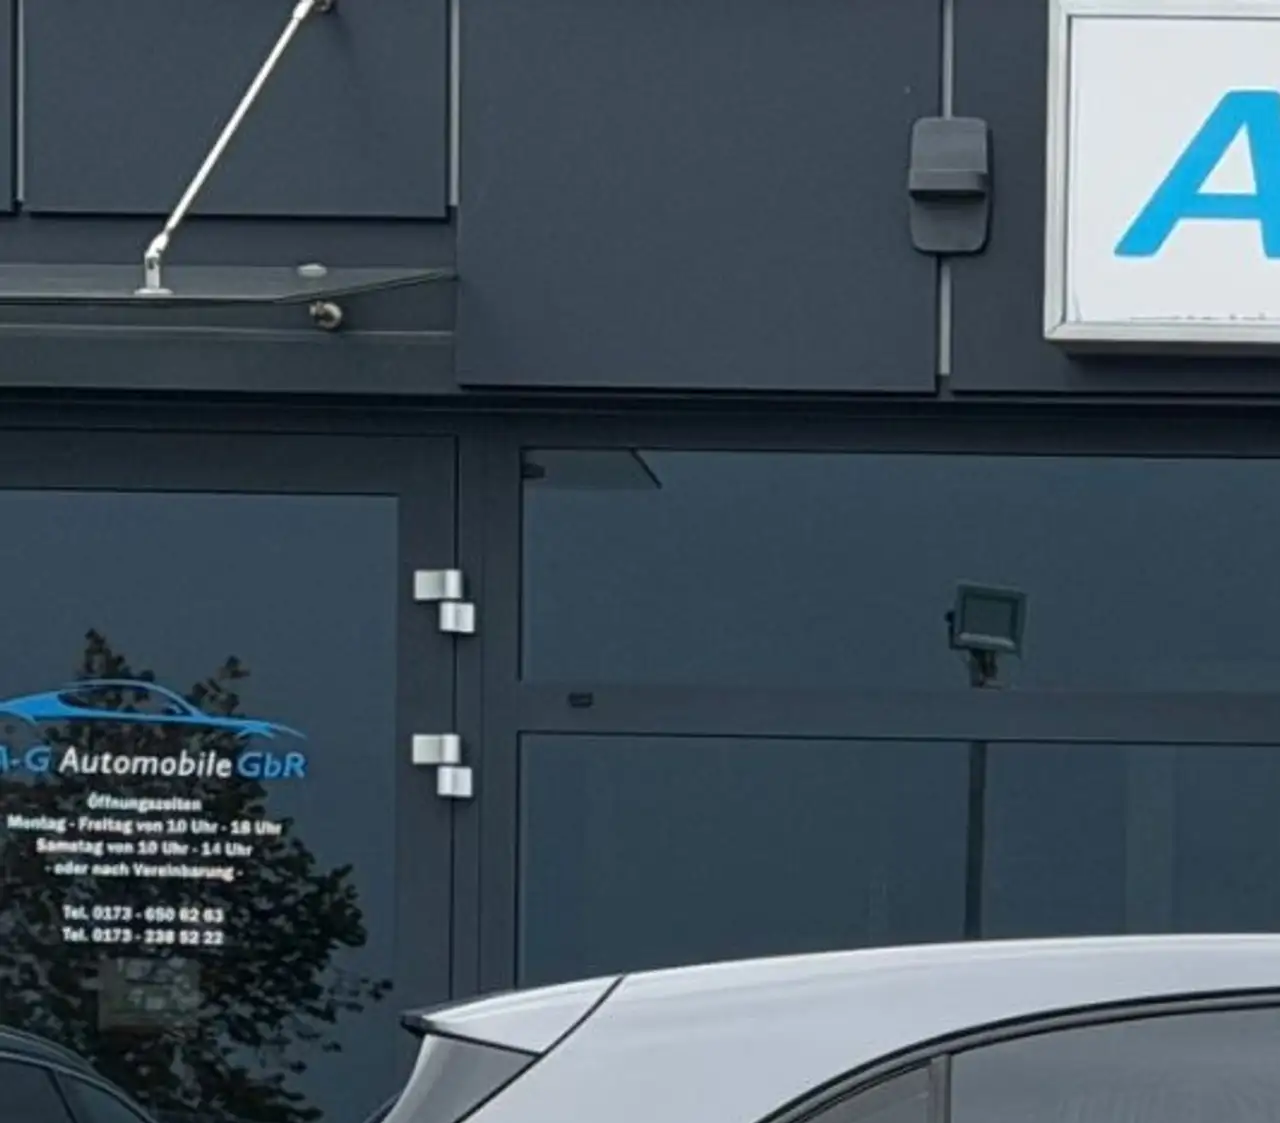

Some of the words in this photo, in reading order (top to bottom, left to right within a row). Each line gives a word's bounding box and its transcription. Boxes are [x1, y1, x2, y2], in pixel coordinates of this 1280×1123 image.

[59, 745, 232, 777] Automobile
[236, 751, 306, 778] GbR
[7, 814, 66, 833] Montag
[78, 816, 133, 835] Freitag
[136, 820, 163, 833] von
[190, 818, 218, 834] Uhr
[254, 820, 282, 835] Uhr
[36, 838, 103, 856] Samstag
[107, 842, 134, 854] von
[161, 840, 189, 855] Uhr
[224, 842, 253, 856] Uhr
[54, 860, 88, 875] oder
[91, 862, 129, 877] nach
[132, 863, 234, 882] Vereinbarung
[62, 905, 89, 920] Tel.
[62, 927, 89, 942] Tel.
